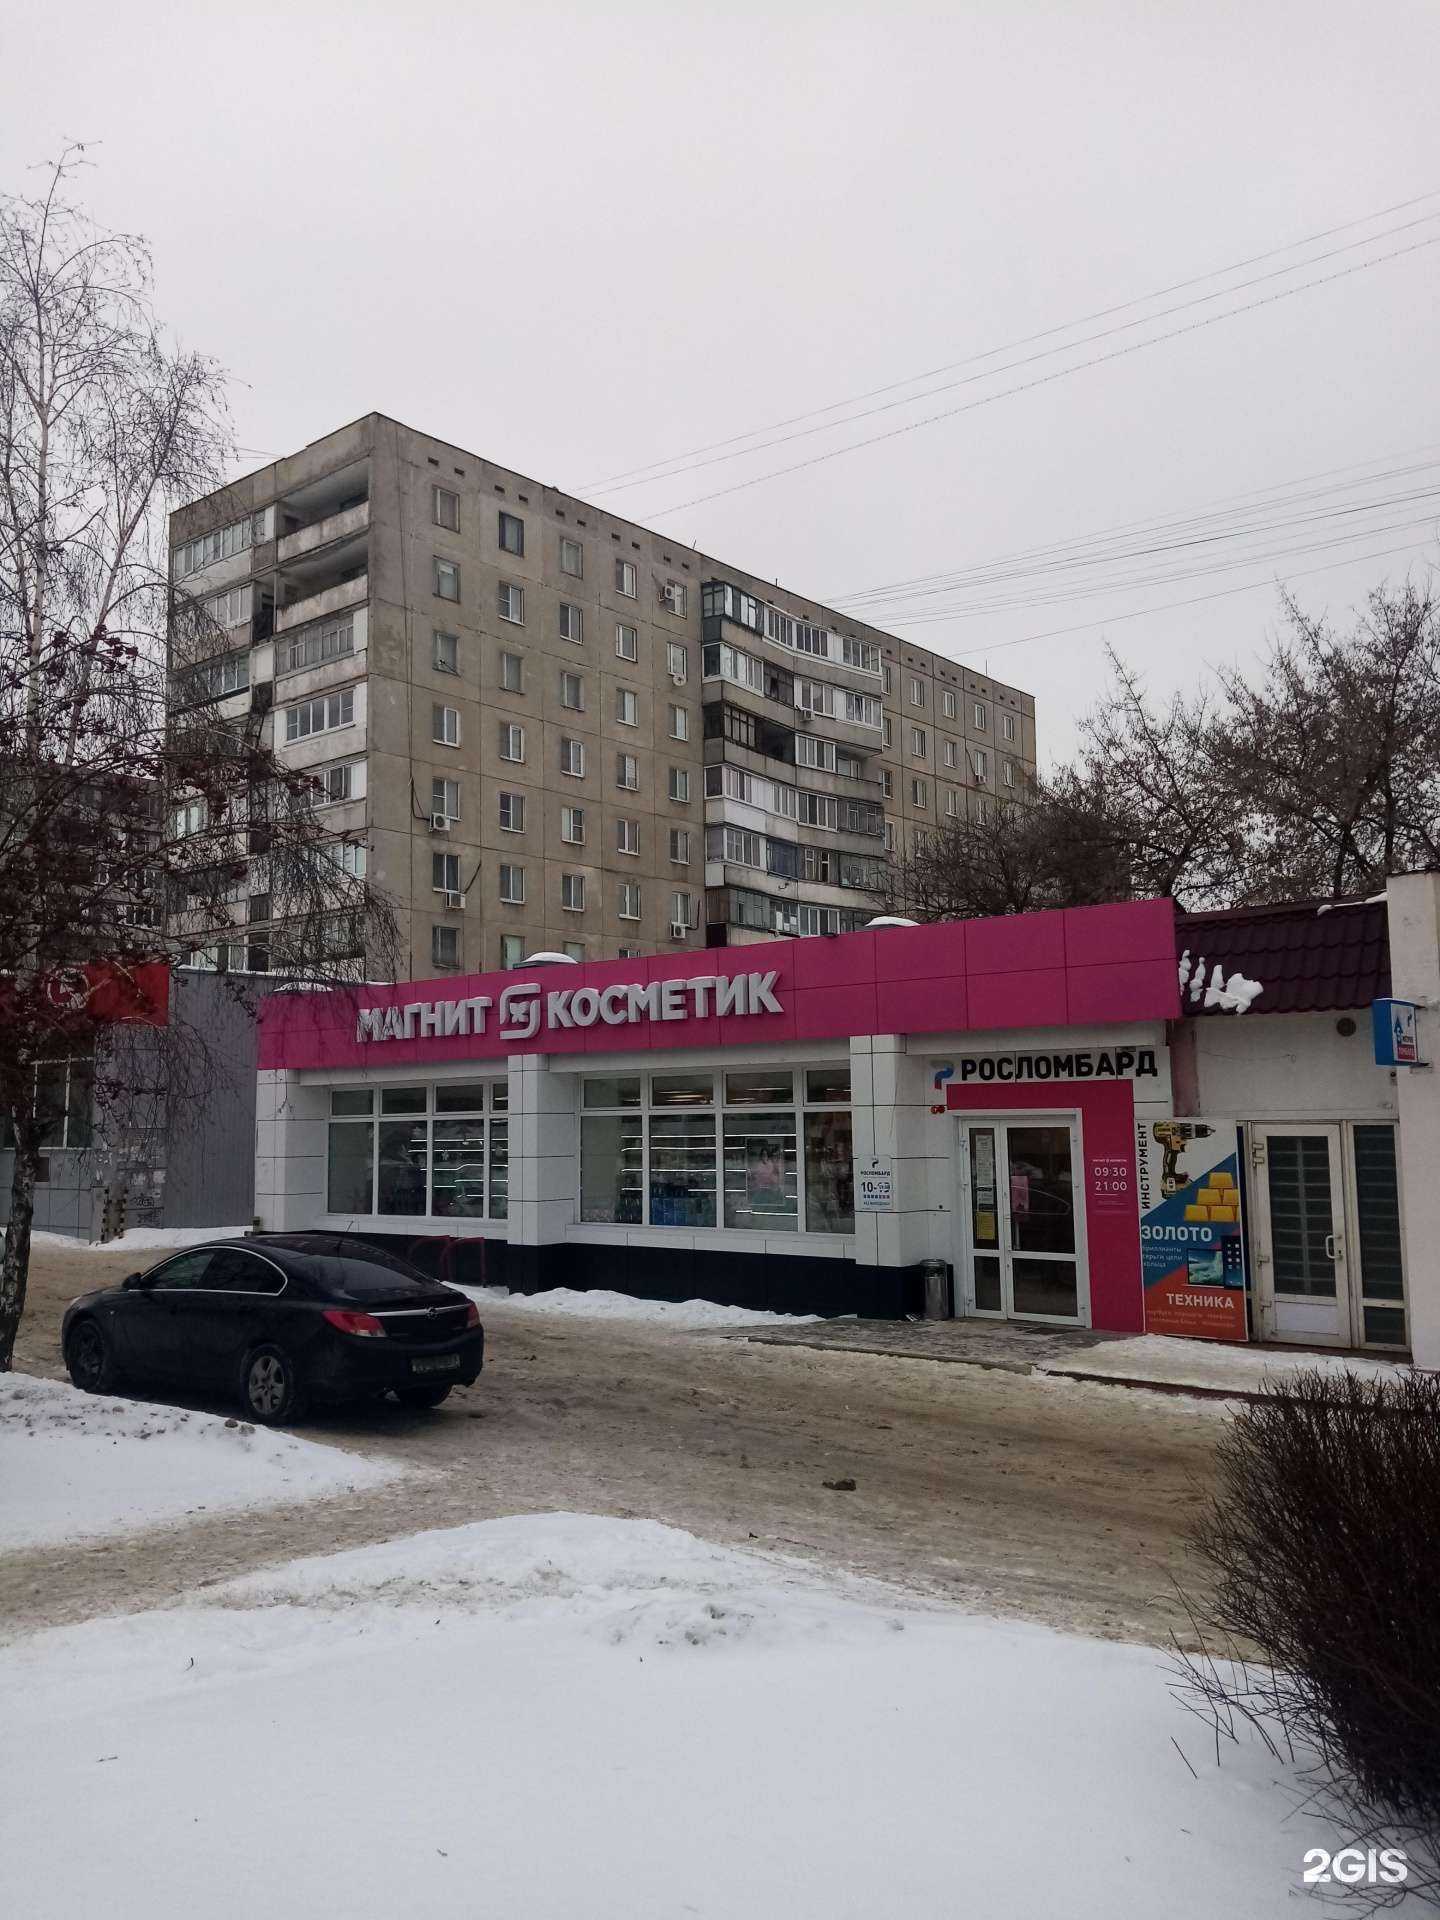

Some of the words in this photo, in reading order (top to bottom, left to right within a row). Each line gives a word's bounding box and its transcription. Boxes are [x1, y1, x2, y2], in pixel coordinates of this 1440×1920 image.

[356, 996, 492, 1042] МАГНИТ
[548, 971, 784, 1029] КОСМЕТИК
[961, 1050, 1158, 1081] РОСЛОМБАРД
[1094, 1167, 1127, 1177] 09:30
[1138, 1123, 1151, 1209] ИНСТРУМЕНТ
[1095, 1181, 1127, 1191] 21:00
[1141, 1225, 1212, 1242] ЗОЛОТО
[1166, 1293, 1234, 1309] ТЕХНИКА
